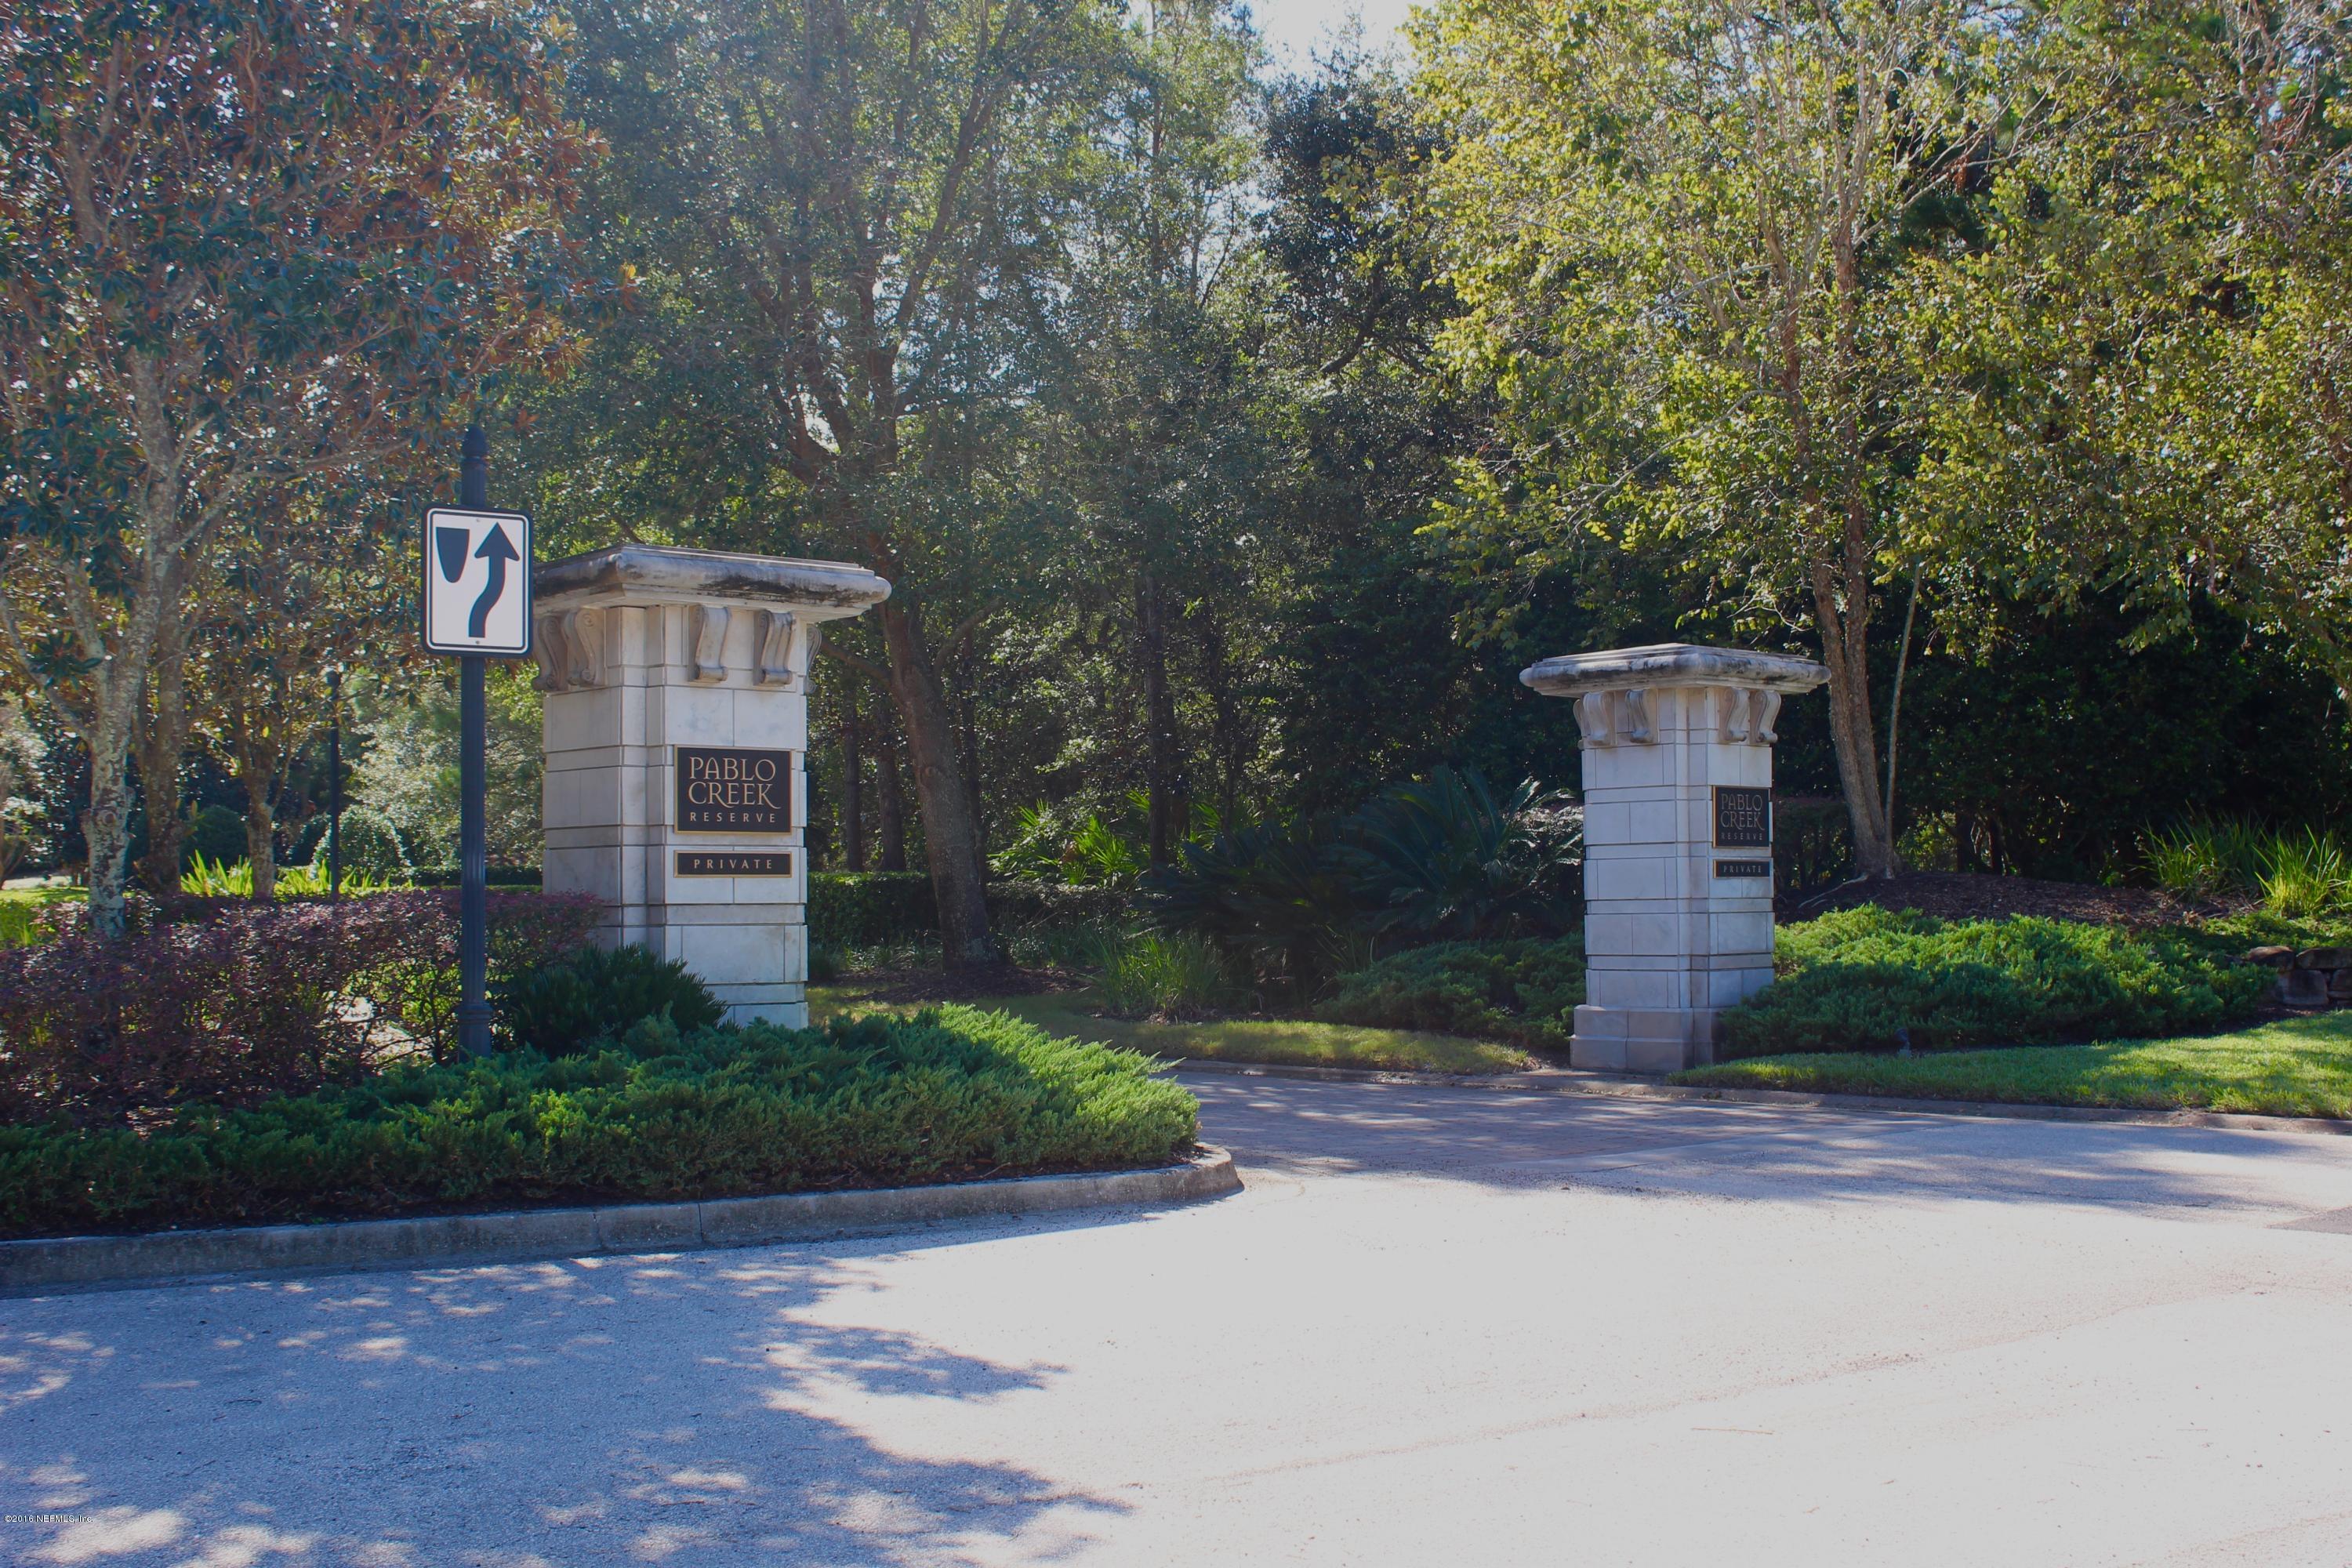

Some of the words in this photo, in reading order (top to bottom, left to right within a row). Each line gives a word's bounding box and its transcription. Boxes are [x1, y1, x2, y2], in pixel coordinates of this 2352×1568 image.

[689, 757, 776, 782] PABLO
[688, 782, 782, 808] CREEK
[1721, 793, 1762, 811] PABLO
[690, 812, 775, 822] RESERVE
[1720, 811, 1765, 830] CREEK
[694, 858, 772, 869] PRIVATE
